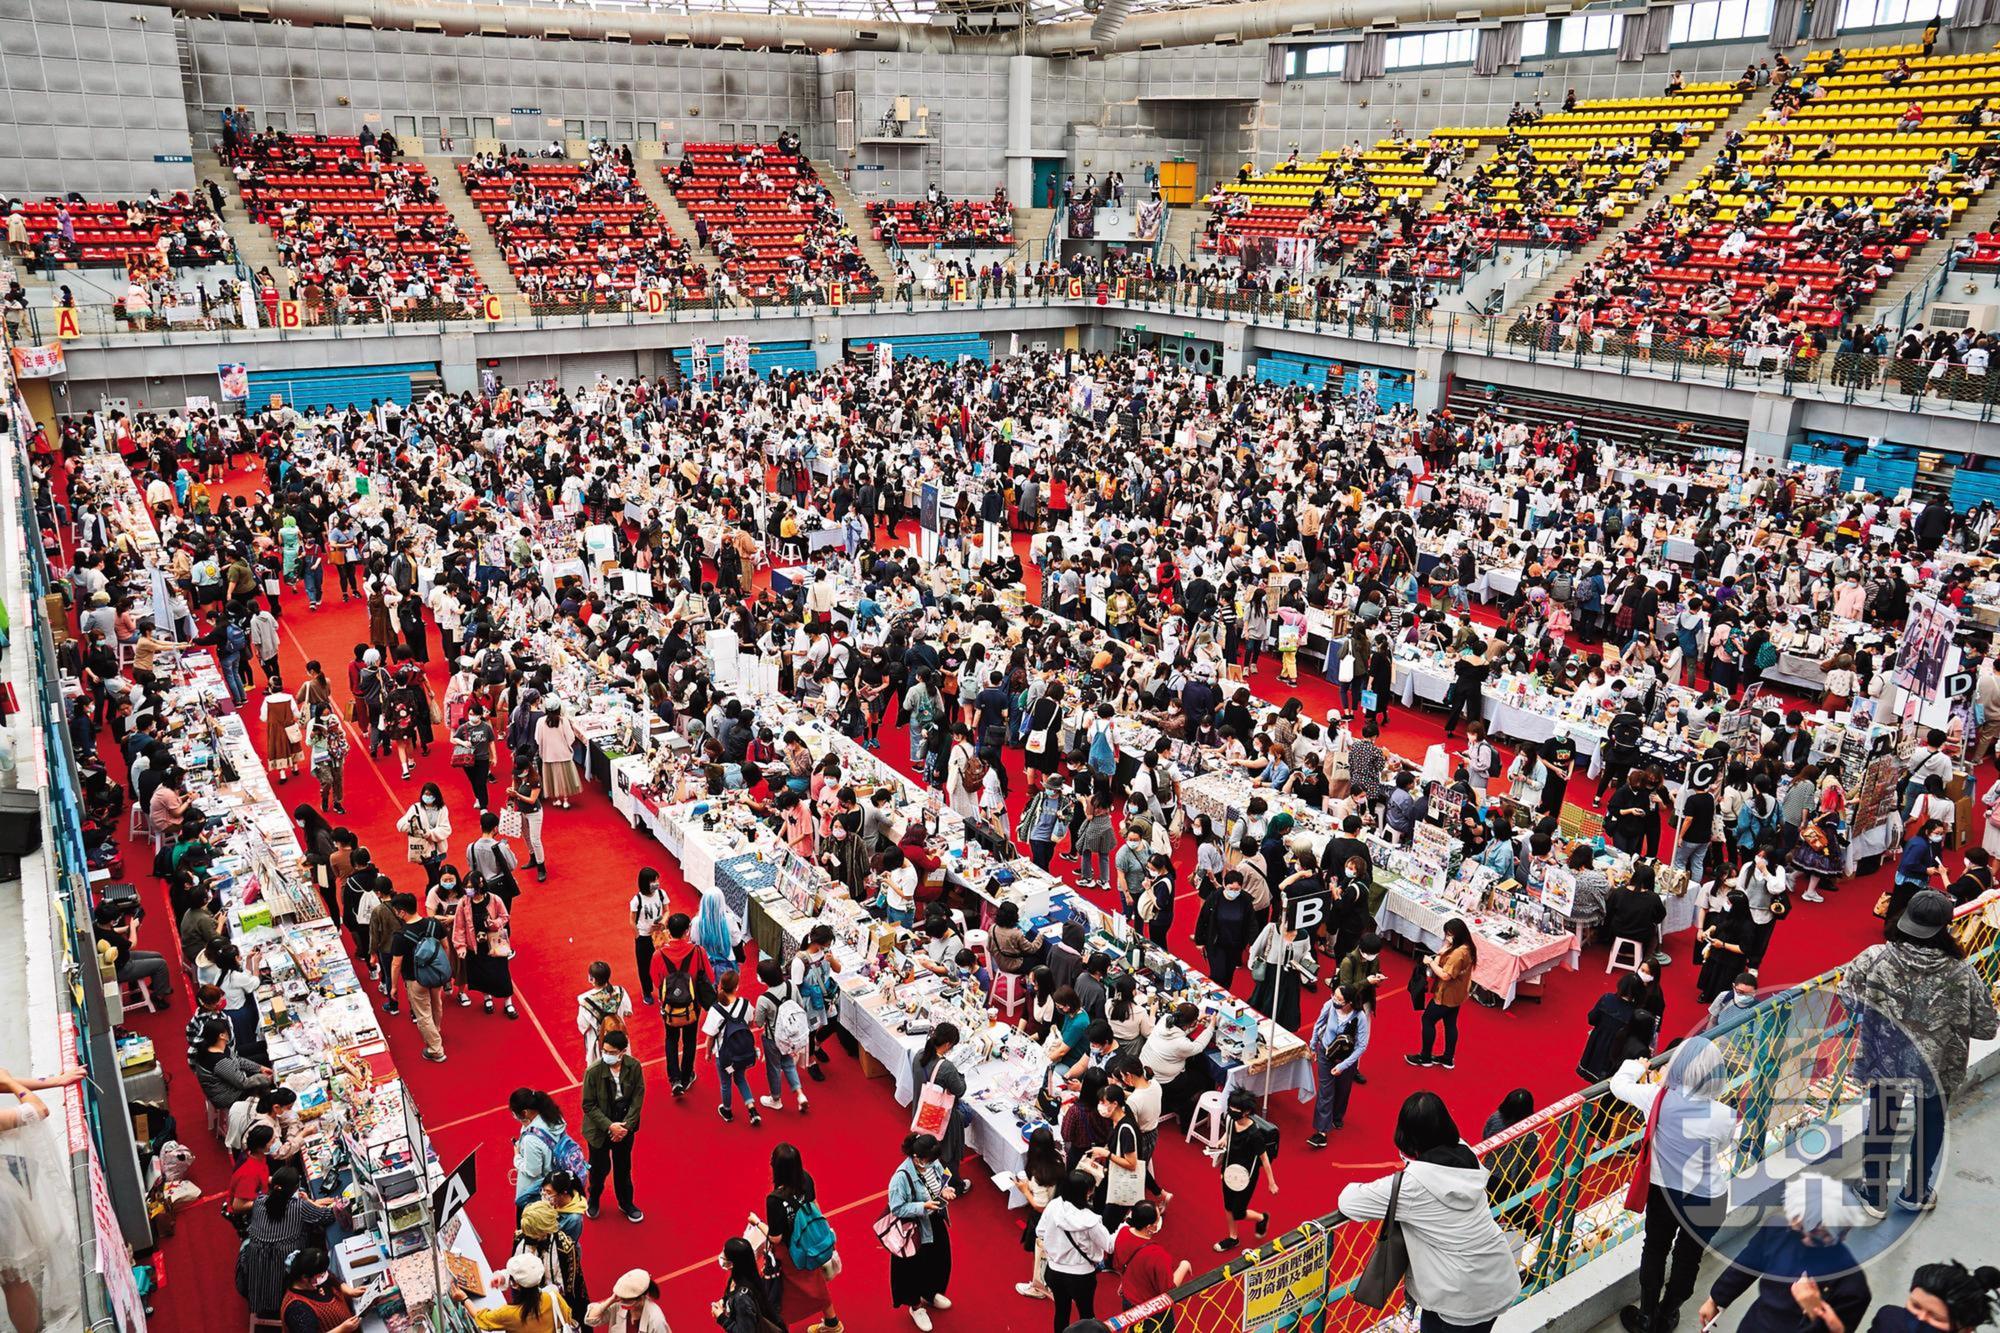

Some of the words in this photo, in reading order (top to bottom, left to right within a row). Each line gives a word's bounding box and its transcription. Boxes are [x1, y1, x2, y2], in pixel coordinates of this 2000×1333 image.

[830, 284, 841, 306] E
[955, 280, 964, 301] F
[1069, 278, 1081, 297] G
[1116, 279, 1127, 298] H
[486, 296, 501, 320] C
[650, 291, 662, 313] D
[59, 310, 78, 336] A
[282, 301, 299, 327] B
[697, 359, 708, 368] D
[1950, 673, 1972, 696] D
[1693, 763, 1714, 786] C
[1295, 897, 1324, 930] B
[440, 1172, 470, 1228] A
[1248, 1241, 1325, 1288] 請勿重壓欄杆
[1248, 1258, 1325, 1301] 勿倚靠及攀爬
[1143, 1294, 1173, 1316] SAFETY
